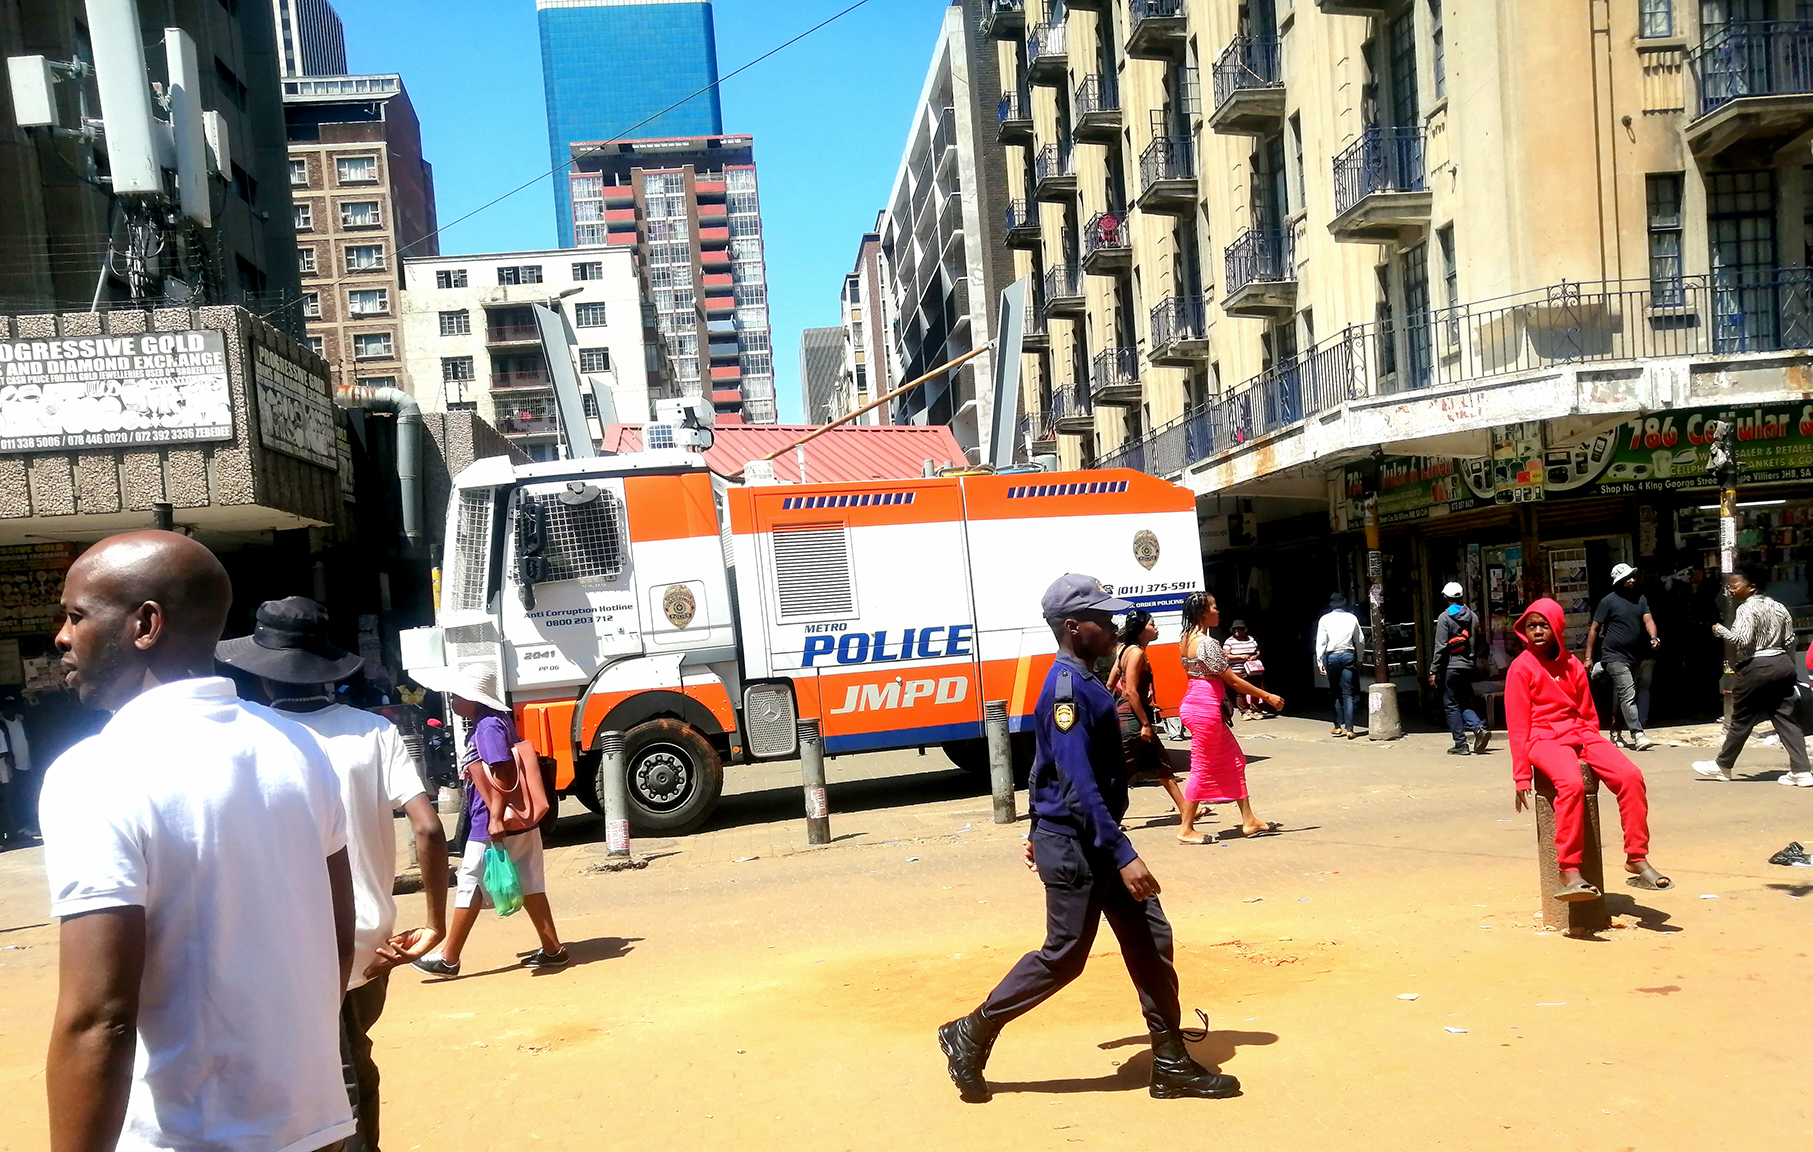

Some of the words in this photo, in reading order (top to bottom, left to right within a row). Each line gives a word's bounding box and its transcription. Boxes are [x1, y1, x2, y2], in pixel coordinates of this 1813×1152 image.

[141, 334, 204, 355] GOLD
[6, 361, 43, 376] AND
[47, 356, 130, 374] DIAMOND
[133, 351, 223, 369] EXCHANGE
[7, 375, 27, 385] CASH
[28, 374, 50, 383] PRICE
[50, 373, 65, 383] FOR
[66, 373, 79, 382] ALL
[79, 372, 98, 381] GOLD
[99, 369, 145, 380] JEWELLERIES
[145, 368, 164, 378] USED
[177, 366, 205, 376] BROKEN
[205, 365, 225, 374] ONES
[1, 439, 16, 450] 011
[17, 437, 35, 449] 338
[36, 436, 60, 448] 5006
[62, 435, 66, 446] /
[67, 434, 84, 446] 078
[86, 433, 103, 444] 446
[104, 432, 127, 444] 0020
[129, 432, 134, 442] /
[135, 431, 151, 442] 072
[153, 430, 170, 441] 392
[171, 428, 194, 440] 3336
[195, 426, 230, 438] ZEBEDEE
[1628, 416, 1679, 450] 786
[1686, 409, 1791, 446] Ceular
[1699, 448, 1763, 461] WSALER
[1765, 447, 1773, 456] &
[1670, 465, 1705, 476] CELLPH
[1748, 457, 1785, 469] ANKETS
[1788, 457, 1795, 465] &
[1600, 484, 1620, 494] Shop
[1622, 483, 1637, 492] No.
[1638, 482, 1643, 490] 4
[1645, 481, 1663, 491] King
[1665, 479, 1695, 489] George
[1696, 477, 1718, 486] Stree
[1800, 468, 1812, 477] SA
[1118, 585, 1144, 596] (011)
[1146, 581, 1196, 593] 375-5911
[524, 610, 544, 619] Anti
[546, 606, 598, 617] Corruption
[599, 604, 634, 613] Hotline
[1157, 599, 1185, 607] POLICING
[546, 619, 572, 627] 0800
[574, 616, 594, 625] 203
[596, 615, 614, 623] 712
[804, 623, 848, 634] METRO
[523, 650, 556, 660] 2041
[801, 624, 973, 667] POLICE
[830, 675, 969, 715] JMPD
